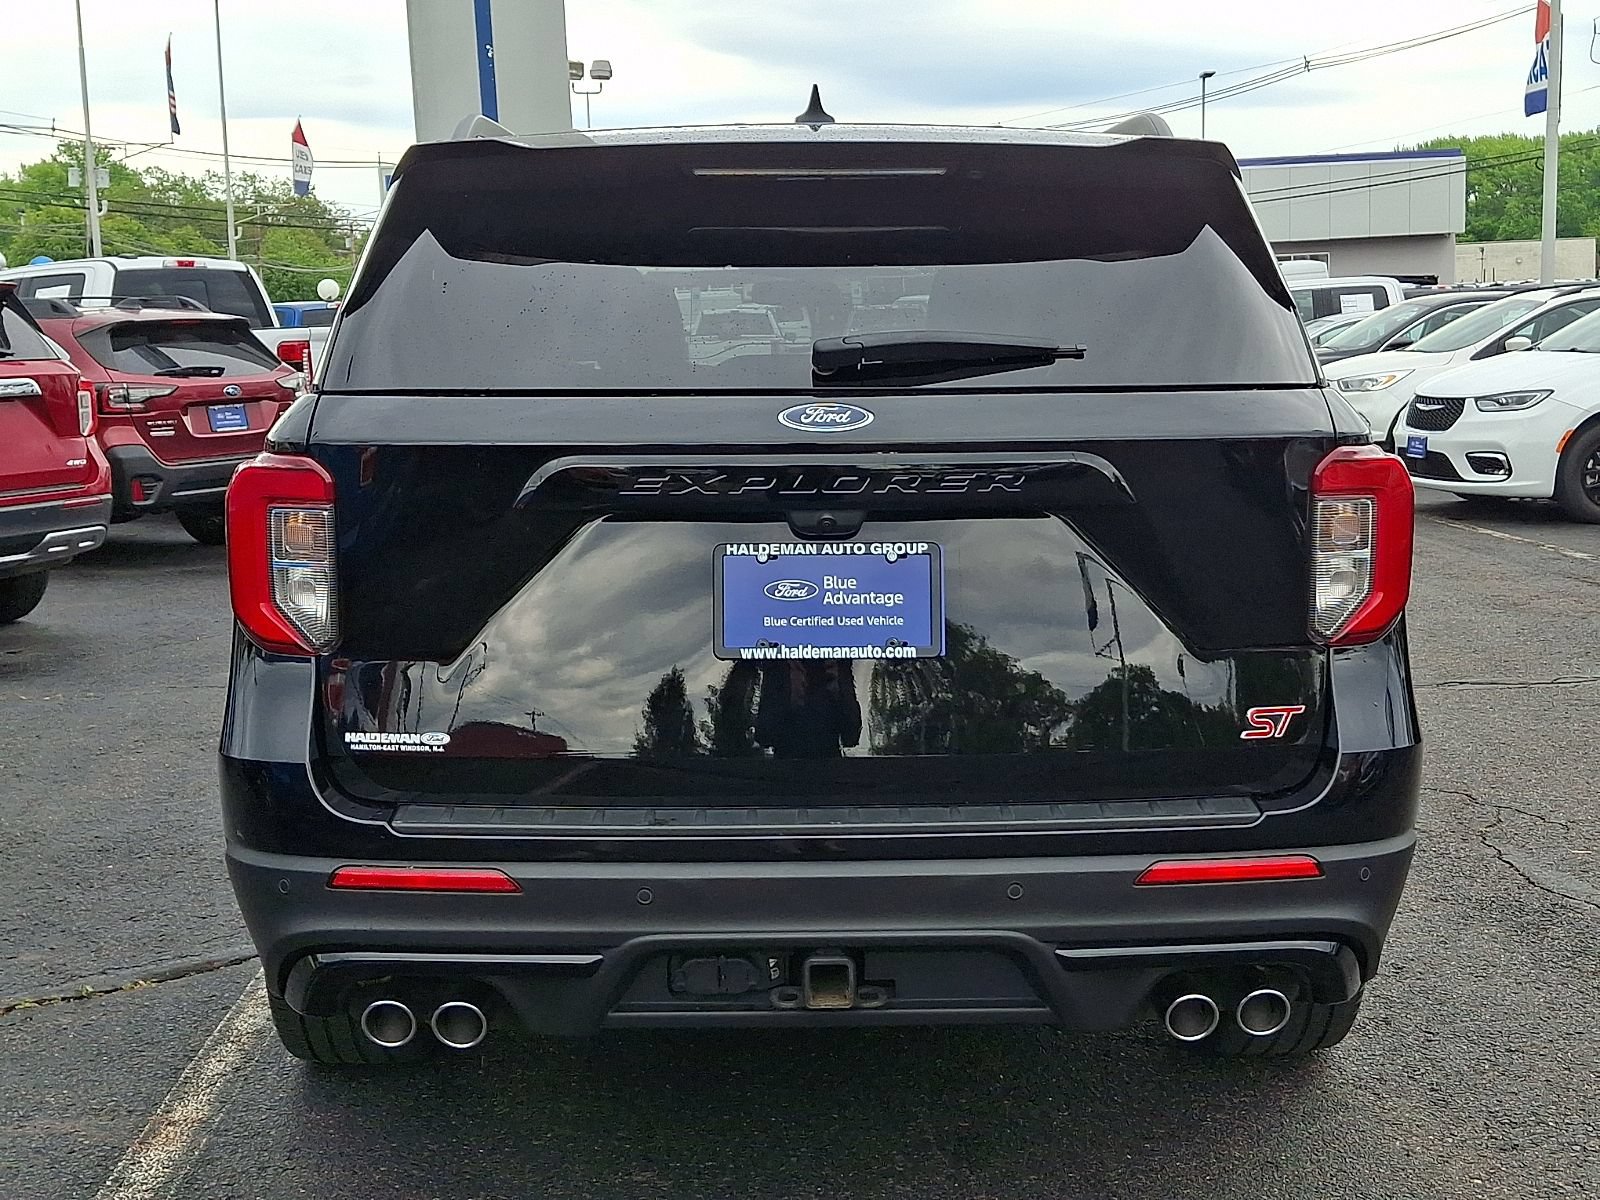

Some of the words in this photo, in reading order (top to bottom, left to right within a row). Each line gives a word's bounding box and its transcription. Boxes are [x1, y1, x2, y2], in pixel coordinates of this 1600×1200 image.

[800, 406, 851, 424] Ford
[618, 473, 1026, 496] EXPLORER
[726, 543, 818, 555] HALDEMAN
[821, 543, 866, 554] AUTO
[872, 542, 929, 554] GROUP
[774, 581, 808, 598] Ford
[823, 576, 857, 589] Blue
[823, 591, 904, 607] Advantage
[763, 616, 787, 627] Blue
[790, 616, 834, 627] Certified
[837, 616, 864, 626] Used
[866, 616, 904, 626] Vehicle
[740, 644, 917, 659] www.haldemanauto.com
[1240, 705, 1306, 739] ST
[344, 732, 421, 743] HALDEMAN
